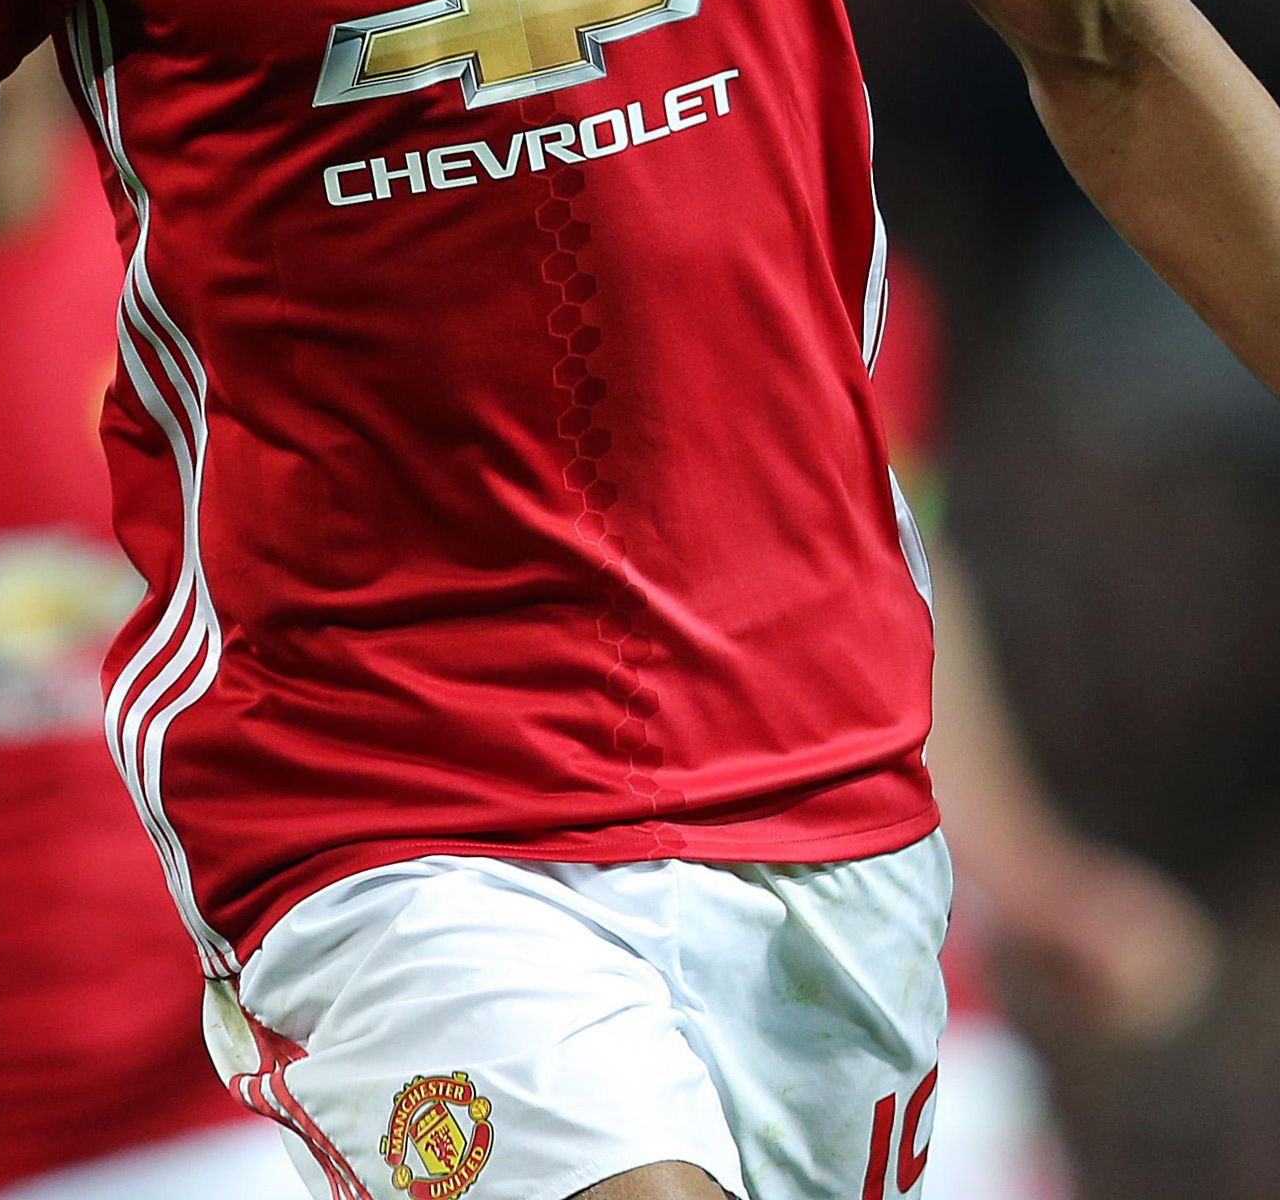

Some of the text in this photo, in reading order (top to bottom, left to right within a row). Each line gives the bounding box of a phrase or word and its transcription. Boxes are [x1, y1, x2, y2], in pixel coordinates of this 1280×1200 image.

[323, 69, 739, 207] CHEVROLET
[391, 1082, 464, 1154] MANCHESTER
[430, 1146, 484, 1198] UNITED
